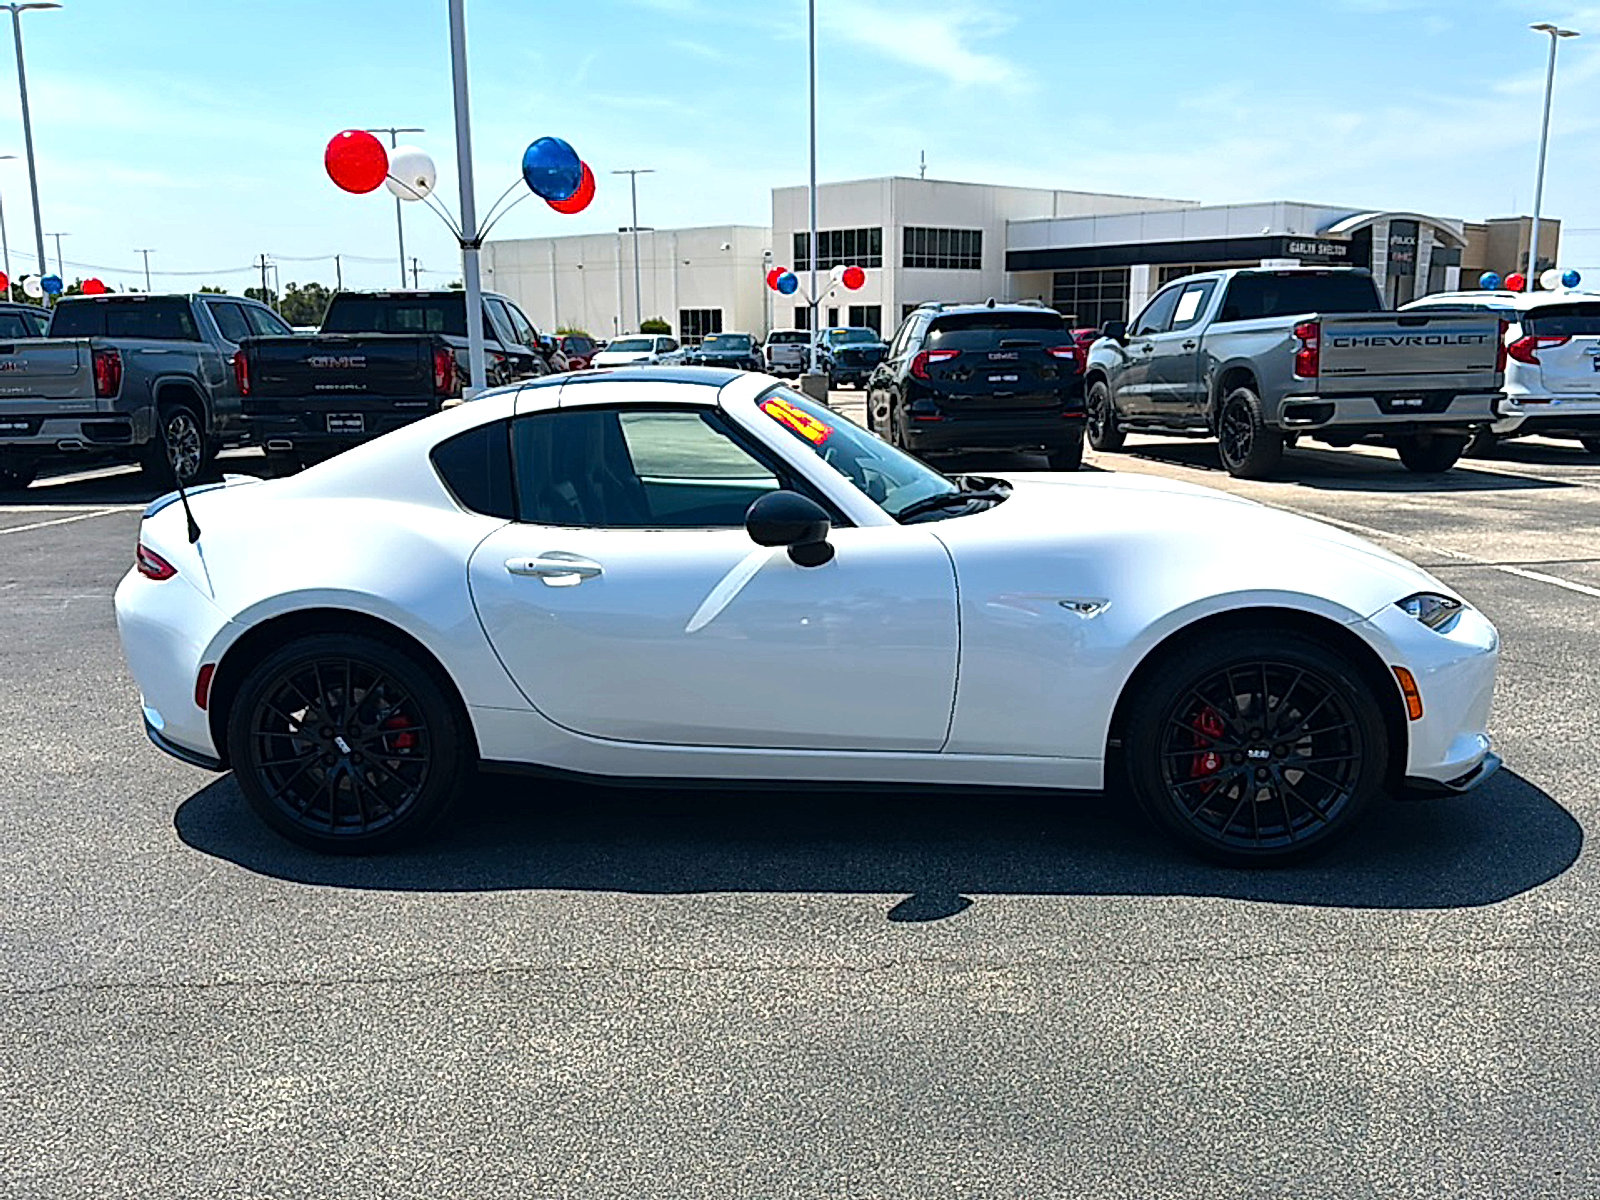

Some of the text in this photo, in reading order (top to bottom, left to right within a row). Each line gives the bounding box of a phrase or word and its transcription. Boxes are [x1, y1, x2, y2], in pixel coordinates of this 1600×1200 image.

[1318, 243, 1347, 256] SHELTON
[1333, 335, 1488, 348] CHEVROLET
[311, 356, 367, 368] GMC
